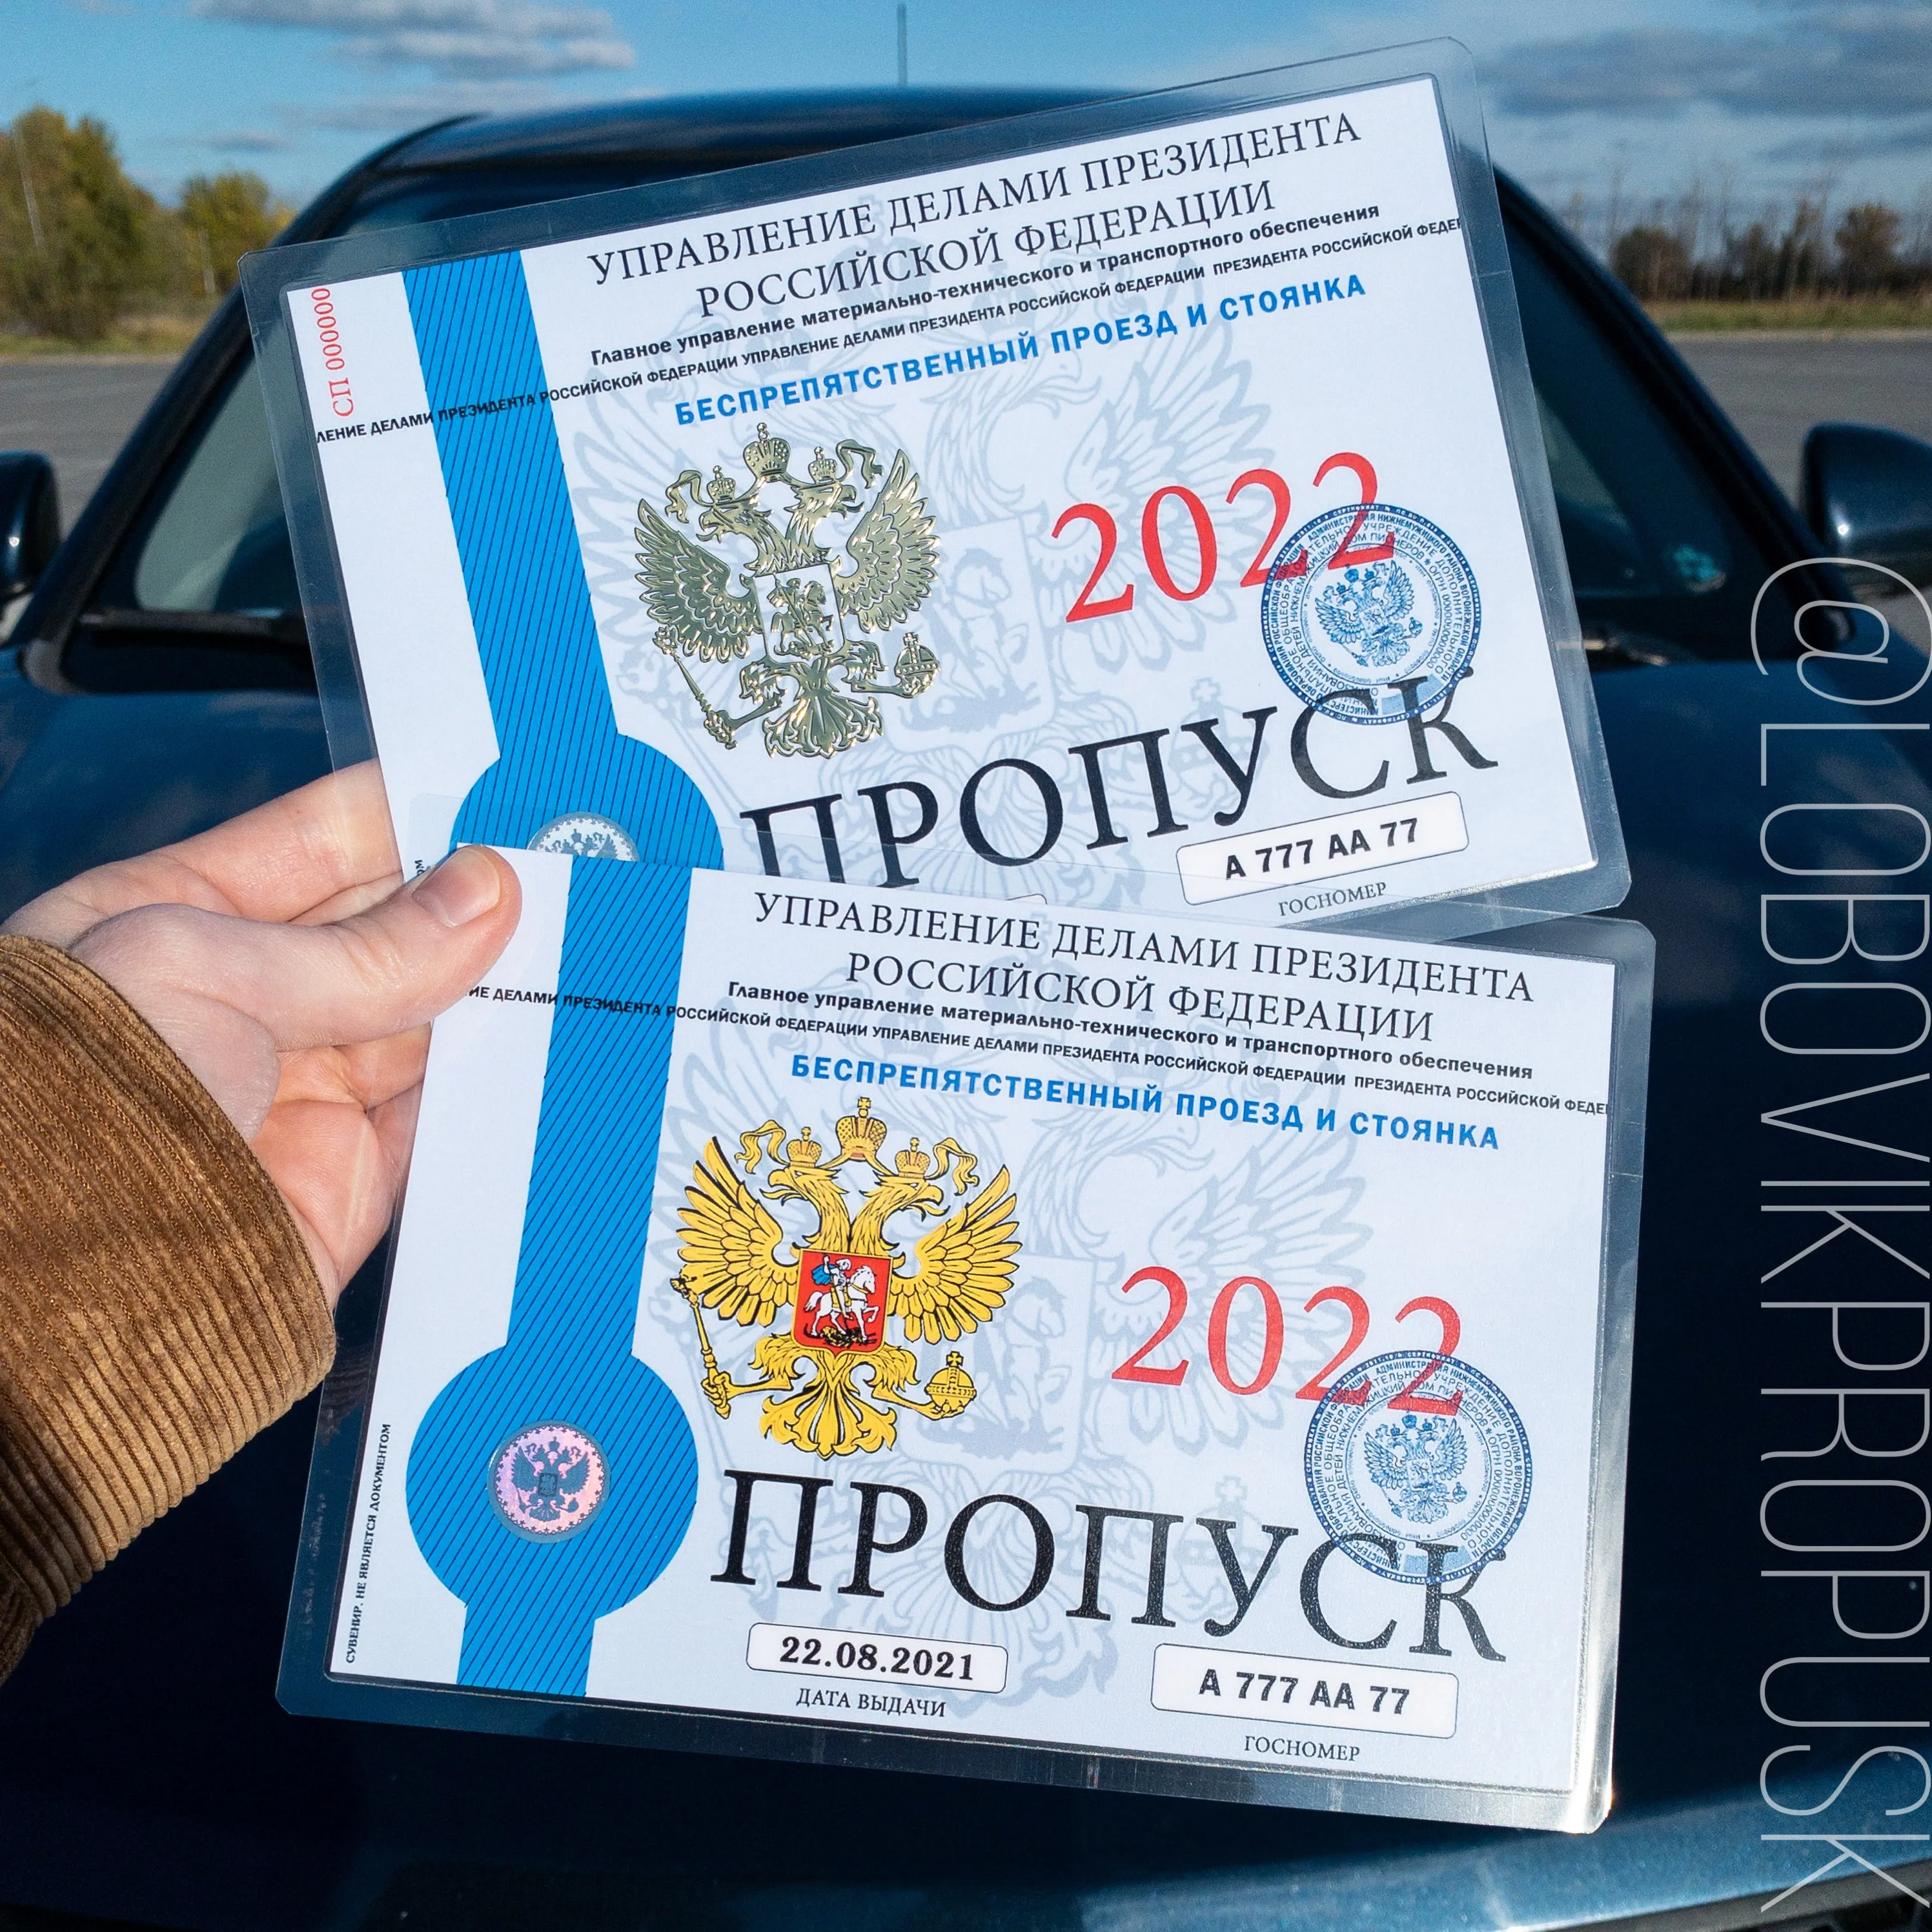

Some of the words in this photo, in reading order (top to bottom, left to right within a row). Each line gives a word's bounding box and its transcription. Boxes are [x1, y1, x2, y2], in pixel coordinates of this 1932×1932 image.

[587, 205, 875, 285] УПРАВЛЕНИЕ
[888, 167, 1071, 236] ДЕЛАМИ
[1081, 113, 1361, 192] ПРЕЗИДЕНТА
[591, 341, 671, 365] Главное
[677, 318, 795, 353] управление
[802, 265, 1073, 325] материально-технического
[1081, 261, 1092, 272] и
[1097, 232, 1243, 271] транспортного
[1250, 206, 1379, 239] обеспечения
[697, 227, 1002, 318] РОССИЙСКОЙ
[1015, 181, 1275, 256] ФЕДЕРАЦИИ
[311, 288, 345, 371] 000000
[371, 412, 433, 435] ДЕЛАМИ
[438, 394, 536, 422] ПРЕЗИДЕНТА
[540, 374, 642, 403] РОССИЙСКОЙ
[647, 356, 737, 382] ФЕДЕРАЦИИ
[742, 337, 839, 365] УПРАВЛЕНИЕ
[844, 325, 904, 348] ДЕЛАМИ
[910, 306, 1004, 332] ПРЕЗИДЕНТА
[1010, 283, 1110, 314] РОССИЙСКОЙ
[1115, 267, 1205, 292] ФЕДЕРАЦИИ
[1214, 248, 1307, 274] ПРЕЗИДЕНТА
[1312, 225, 1412, 256] РОССИЙСКОЙ
[675, 331, 1038, 425] БЕСПРЕПЯТСТВЕННЫЙ
[1051, 310, 1177, 353] ПРОЕЗД
[1187, 303, 1207, 327] И
[1220, 274, 1365, 320] СТОЯНКА
[329, 378, 354, 417] СП
[1052, 452, 1394, 622] 2022
[740, 666, 1498, 888] ПРОПУСК
[1255, 840, 1313, 874] 777
[1328, 828, 1370, 860] АА
[1381, 818, 1419, 848] 77
[1278, 882, 1387, 917] ГОСНОМЕР
[755, 893, 1039, 949] УПРАВЛЕНИЕ
[1052, 924, 1238, 970] ДЕЛАМИ
[1252, 944, 1533, 1002] ПРЕЗИДЕНТА
[729, 982, 809, 1004] Главное
[814, 994, 933, 1016] управление
[942, 1006, 1218, 1045] материально-технического
[1226, 1035, 1236, 1047] и
[1243, 1038, 1392, 1063] транспортного
[1400, 1052, 1531, 1079] обеспечения
[846, 953, 1155, 1012] РОССИЙСКОЙ
[1169, 986, 1433, 1041] ФЕДЕРАЦИИ
[493, 989, 558, 1004] ДЕЛАМИ
[563, 995, 661, 1017] ПРЕЗИДЕНТА
[667, 1006, 770, 1026] РОССИЙСКОЙ
[776, 1017, 867, 1036] ФЕДЕРАЦИИ
[873, 1027, 970, 1046] УПРАВЛЕНИЕ
[974, 1037, 1037, 1053] ДЕЛАМИ
[1043, 1044, 1139, 1063] ПРЕЗИДЕНТА
[1144, 1054, 1248, 1075] РОССИЙСКОЙ
[1254, 1066, 1345, 1085] ФЕДЕРАЦИИ
[1355, 1077, 1450, 1097] ПРЕЗИДЕНТА
[1457, 1088, 1560, 1108] РОССИЙСКОЙ
[1565, 1101, 1608, 1114] ФЕДЕ
[792, 1055, 1162, 1113] БЕСПРЕПЯТСТВЕННЫЙ
[1177, 1093, 1303, 1132] ПРОЕЗД
[1317, 1109, 1335, 1131] И
[1350, 1112, 1498, 1149] СТОЯНКА
[1112, 1266, 1463, 1416] 2022
[369, 1423, 391, 1512] ДОКУМЕНТОМ
[356, 1582, 367, 1599] НЕ
[359, 1515, 378, 1580] ЯВЛЯЕТСЯ
[711, 1469, 1506, 1662] ПРОПУСК
[779, 1636, 973, 1681] 22.08.2021
[796, 1687, 850, 1709] ДАТА
[857, 1693, 947, 1717] ВЫДАЧИ
[1235, 1671, 1299, 1703] 777
[1308, 1680, 1356, 1710] АА
[1369, 1685, 1410, 1714] 77
[1245, 1735, 1360, 1762] ГОСНОМЕР
